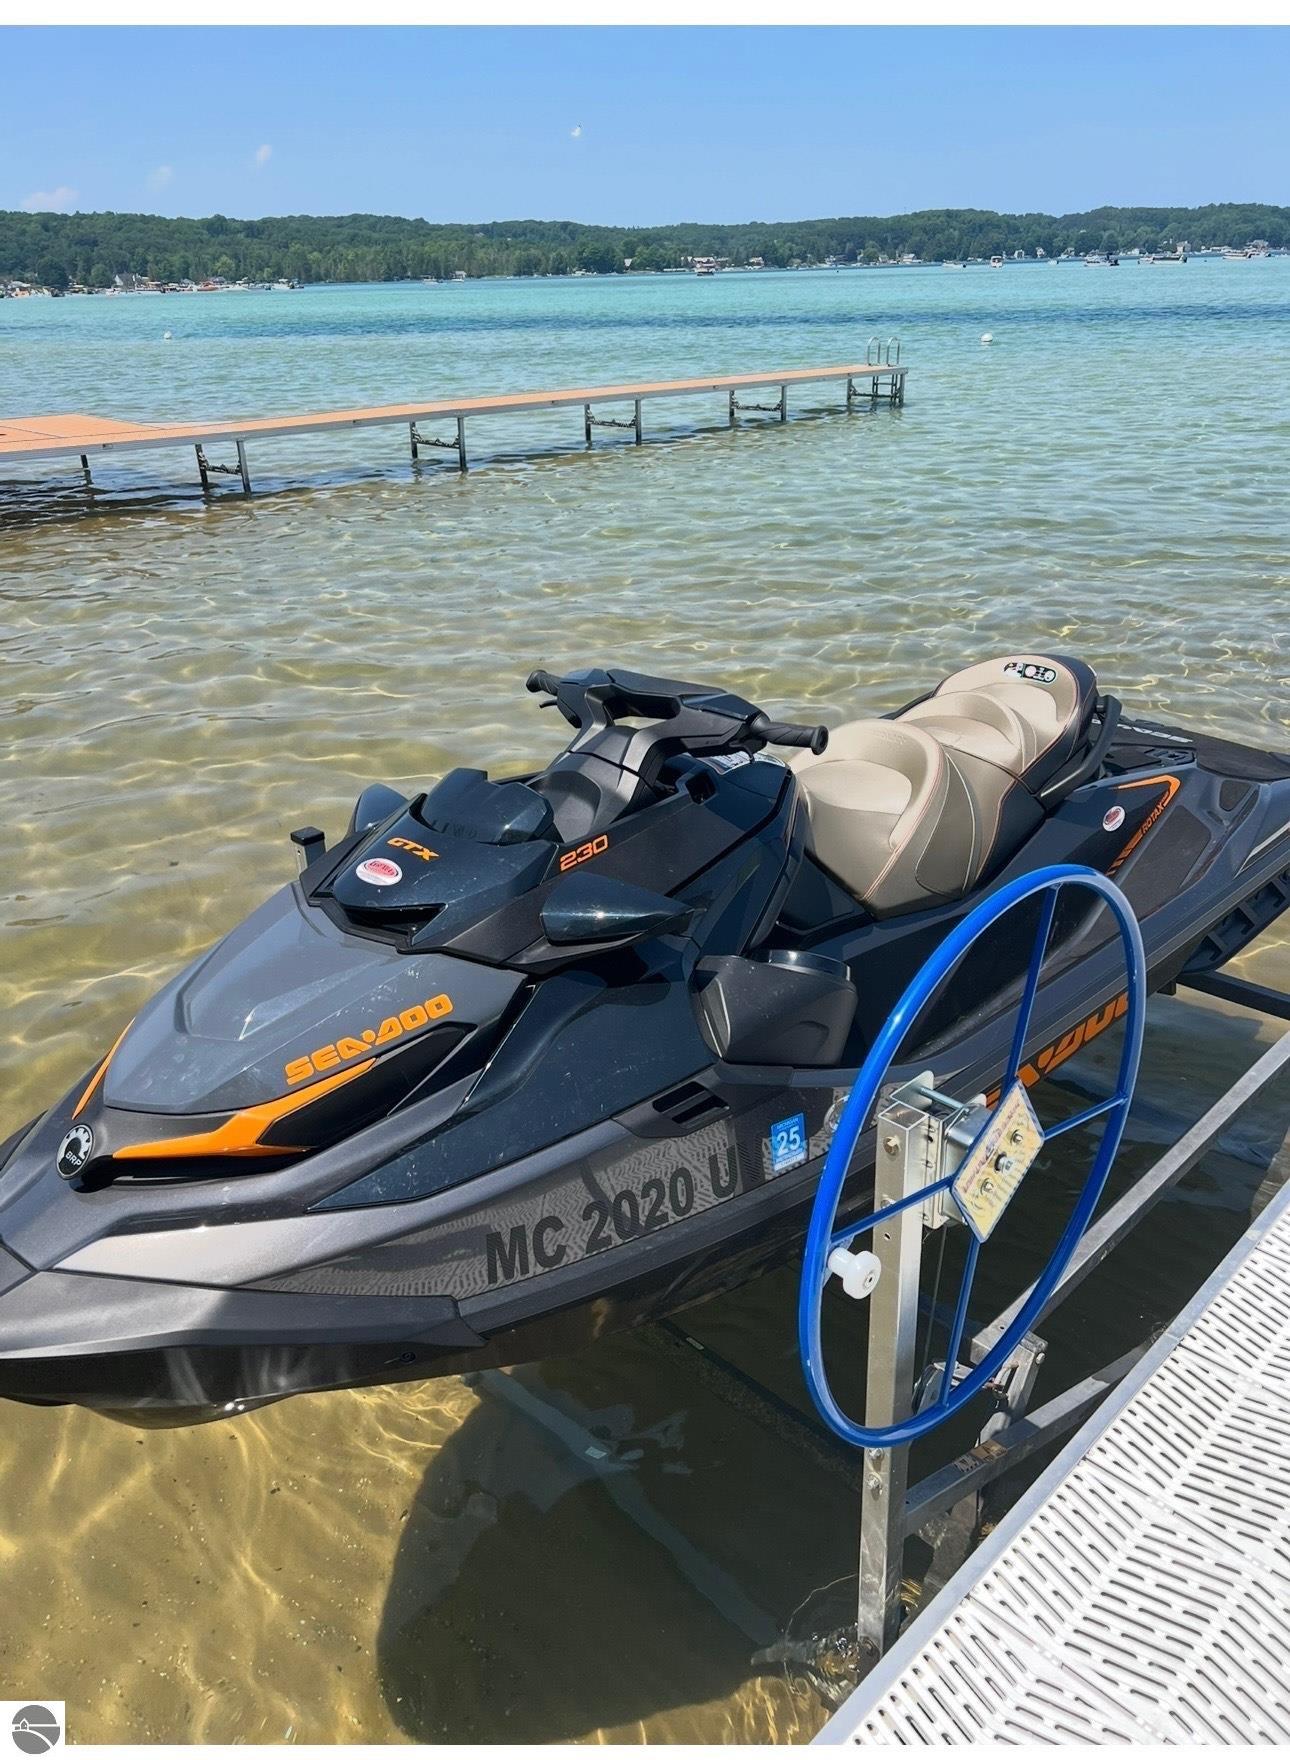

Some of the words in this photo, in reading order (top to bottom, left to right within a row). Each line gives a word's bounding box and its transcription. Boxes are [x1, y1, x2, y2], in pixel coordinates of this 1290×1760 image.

[1141, 803, 1165, 834] ROTAX
[386, 837, 440, 862] GTX
[559, 834, 609, 872] 230
[776, 1126, 801, 1157] 25
[65, 1151, 83, 1167] BRP
[486, 1215, 568, 1286] MC
[582, 1166, 696, 1255] 2020
[708, 1142, 739, 1201] U
